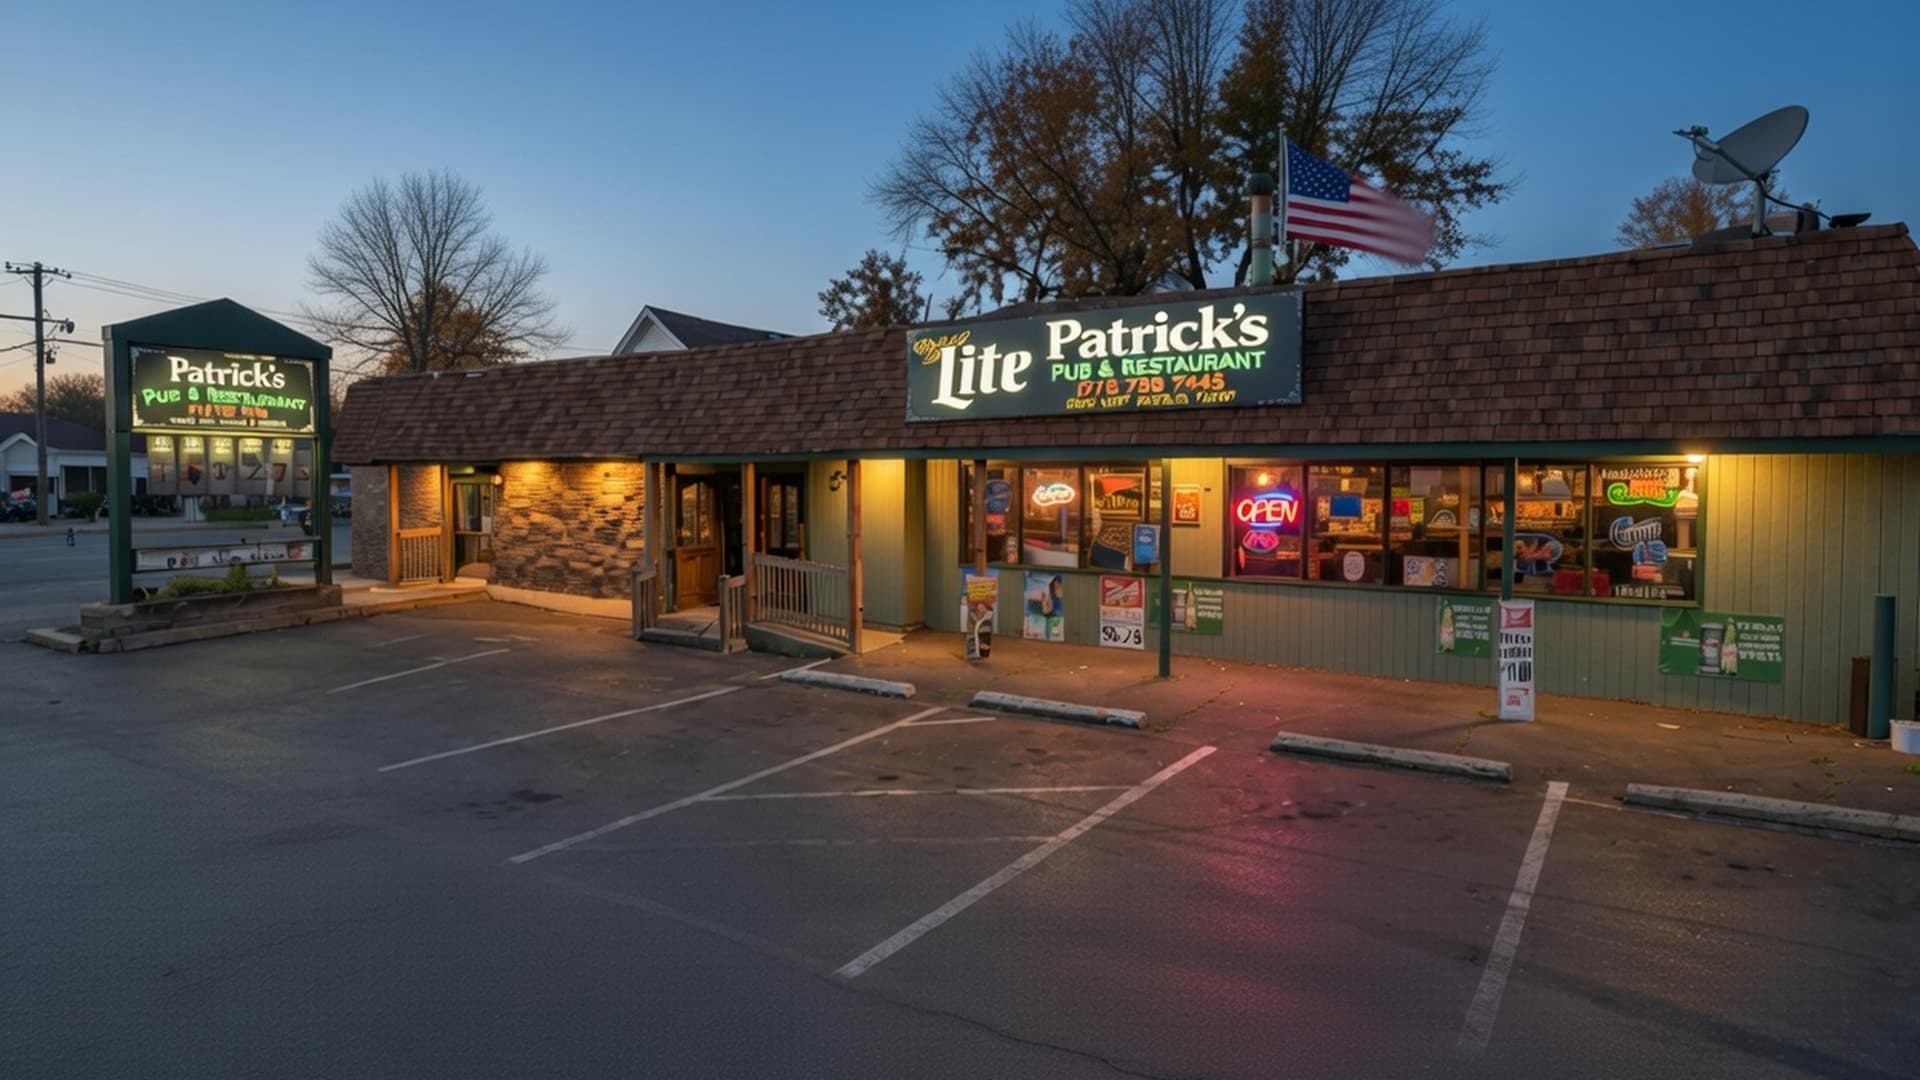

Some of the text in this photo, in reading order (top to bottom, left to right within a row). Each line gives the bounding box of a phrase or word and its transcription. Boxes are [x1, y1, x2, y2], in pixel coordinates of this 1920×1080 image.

[1046, 303, 1269, 361] Patrick's
[168, 356, 286, 389] Patrick's
[932, 342, 1032, 410] Lite
[1051, 351, 1266, 382] PUB & RESTAURANT
[1237, 499, 1298, 523] OPEN
